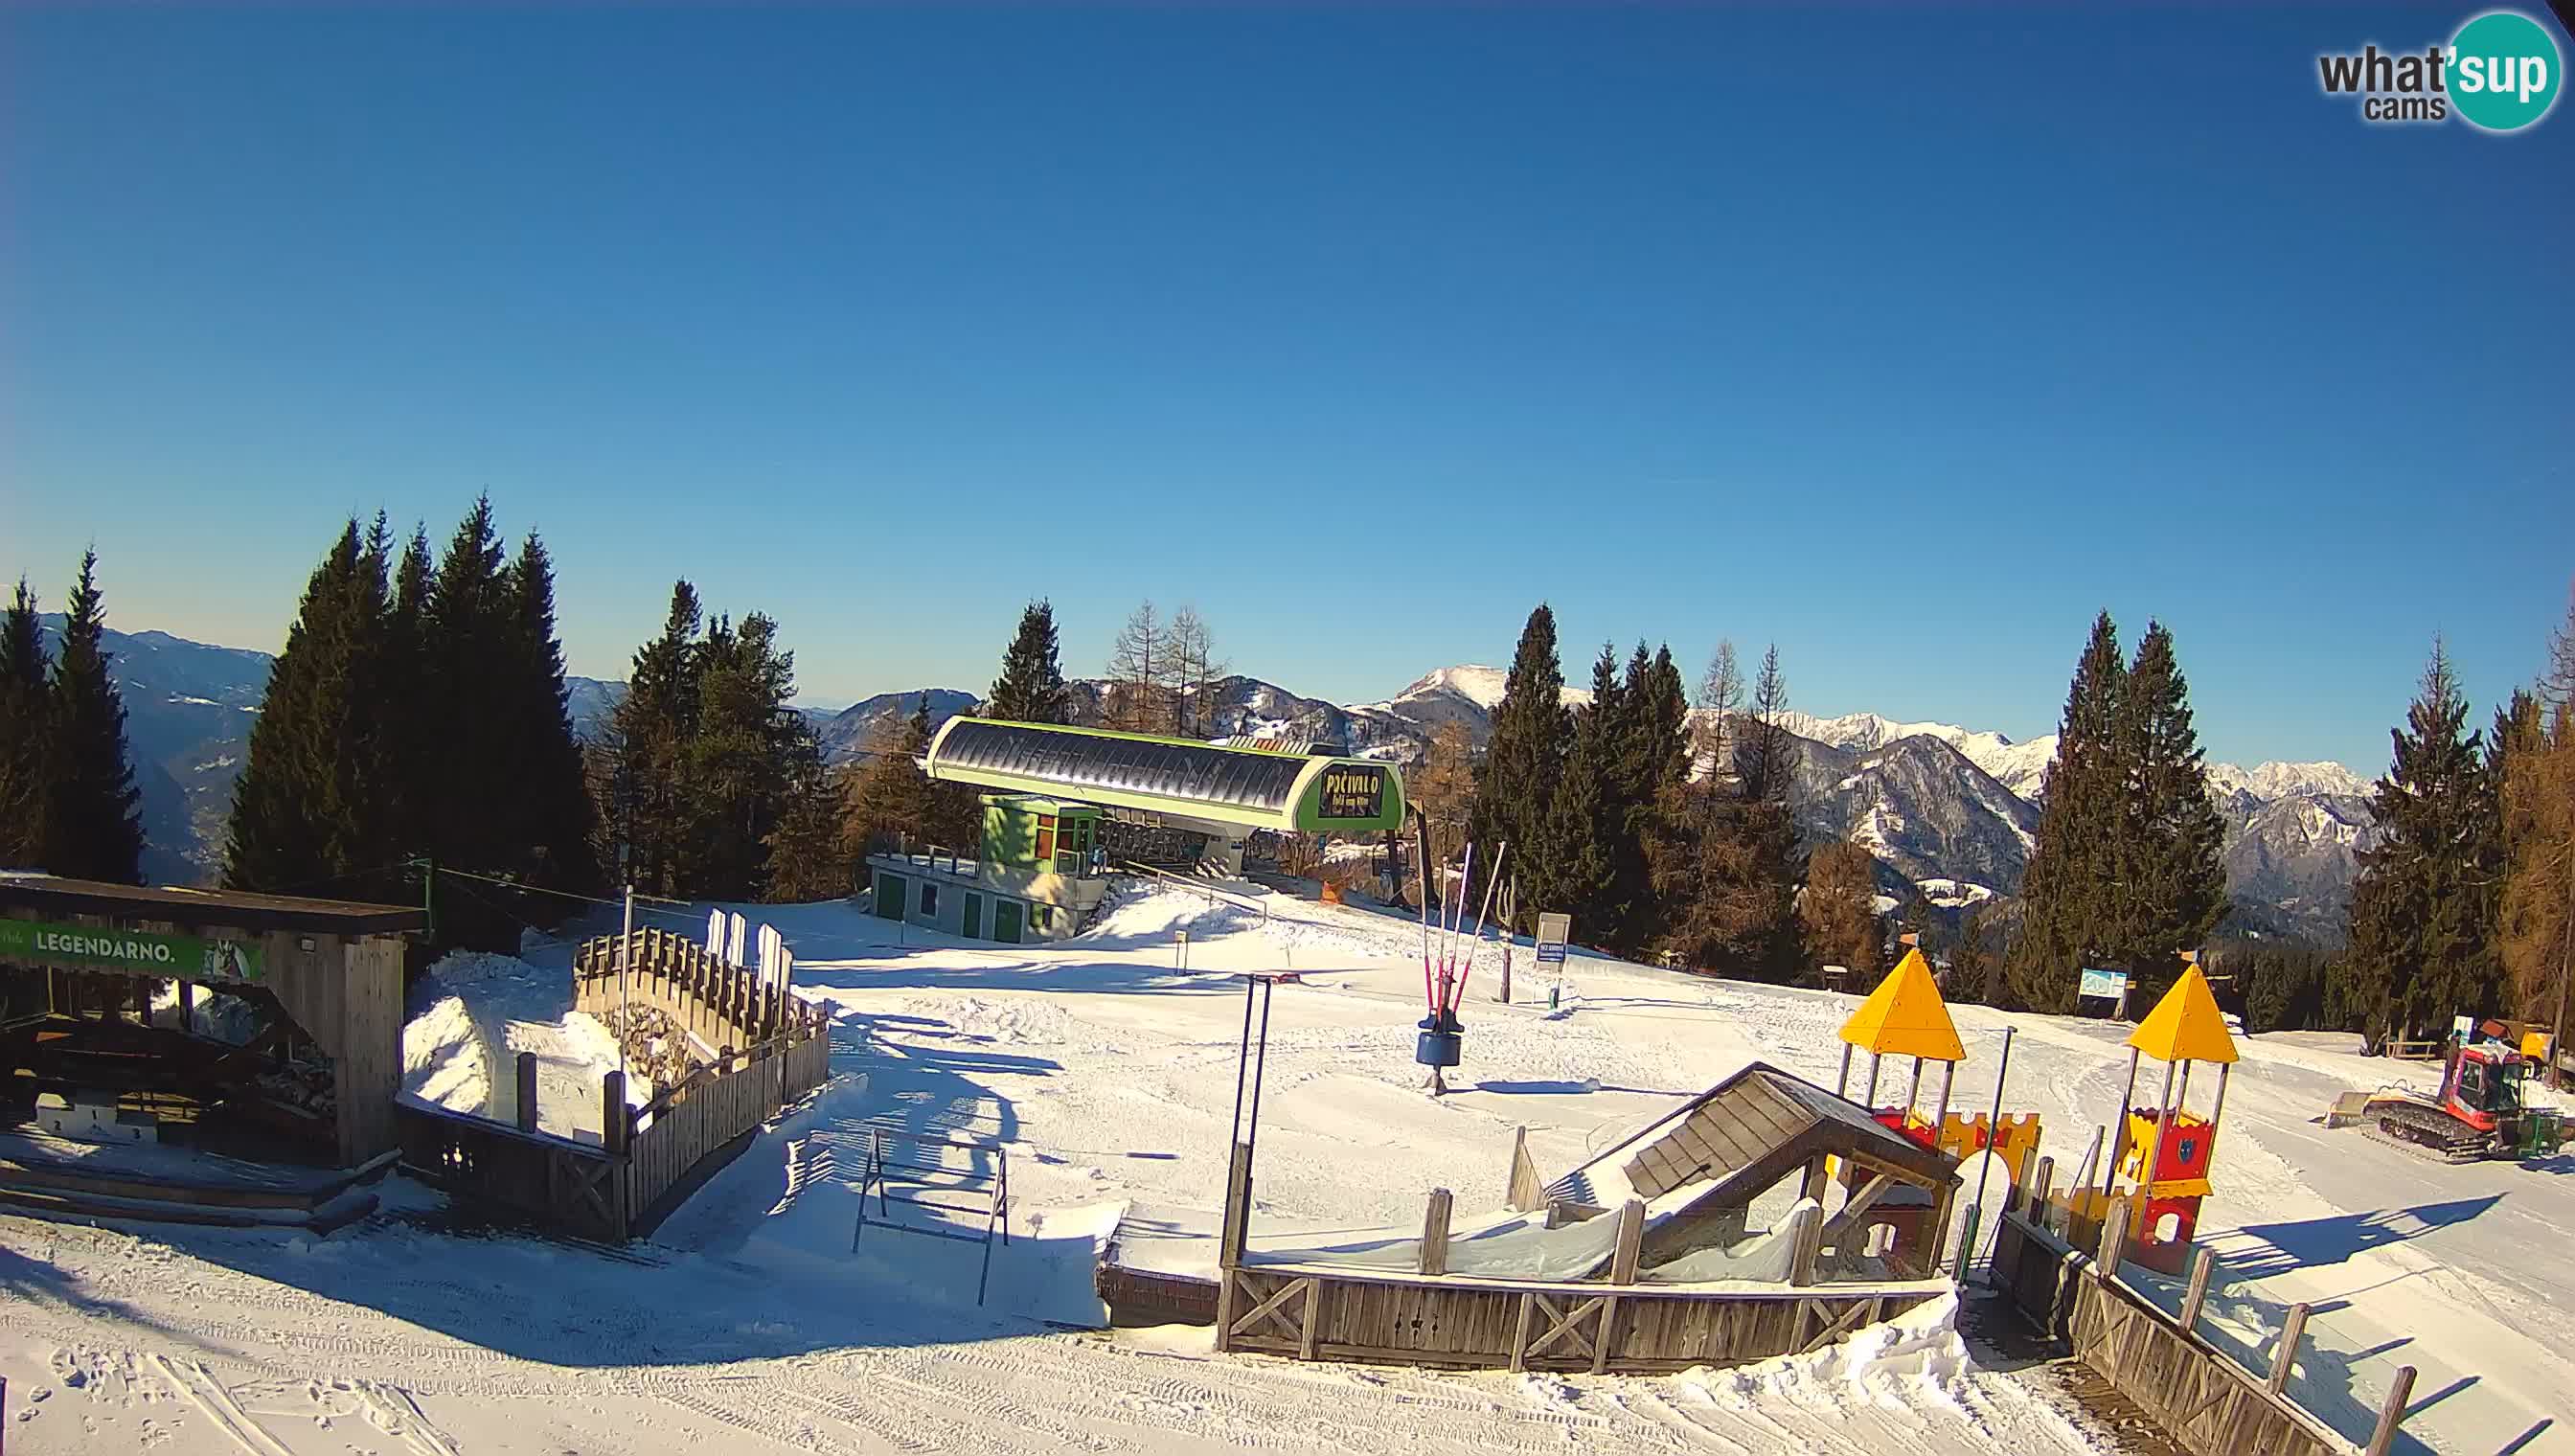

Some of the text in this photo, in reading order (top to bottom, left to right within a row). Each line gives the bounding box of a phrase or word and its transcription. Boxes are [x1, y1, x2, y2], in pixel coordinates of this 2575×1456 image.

[36, 932, 175, 963] LEGENDARNO.
[92, 1109, 98, 1120] 1
[54, 1120, 61, 1131] 2
